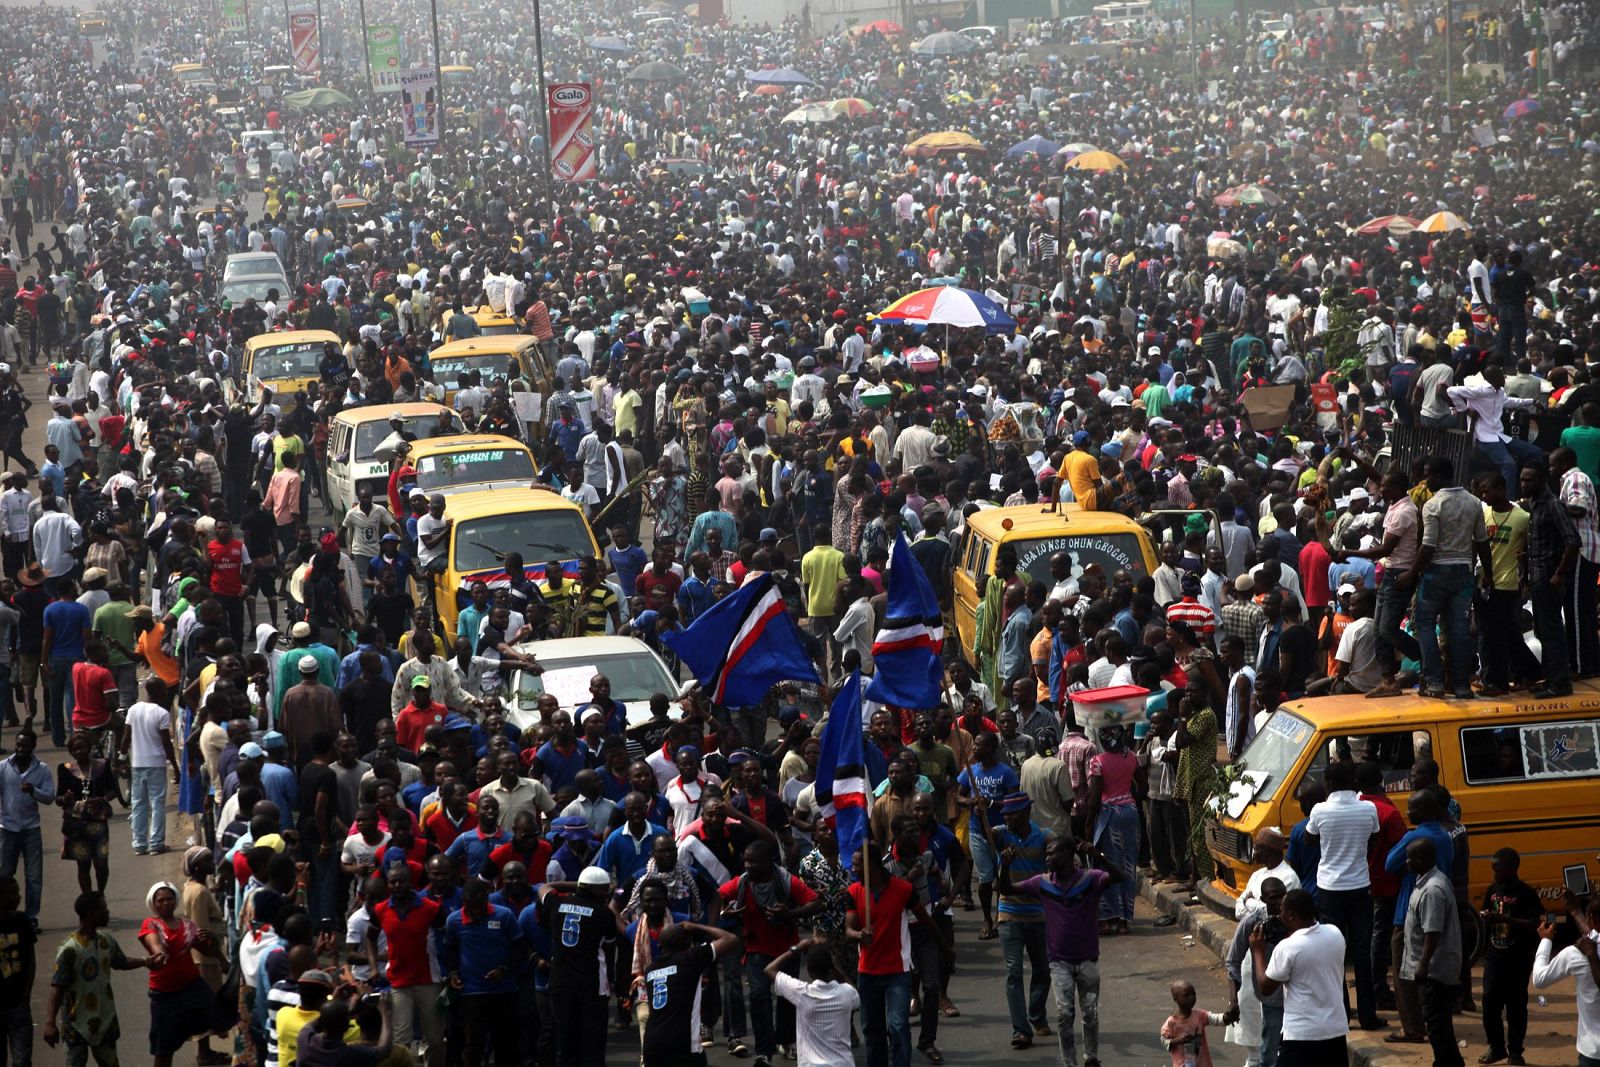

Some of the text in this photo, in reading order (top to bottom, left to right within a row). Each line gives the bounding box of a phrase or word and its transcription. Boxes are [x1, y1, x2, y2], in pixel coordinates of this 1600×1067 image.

[556, 90, 583, 100] Gala
[578, 132, 592, 144] Gala
[558, 160, 571, 173] Gala
[1016, 549, 1037, 572] BABA
[1068, 538, 1094, 549] OHUN
[1094, 540, 1130, 566] GBOGBO
[1513, 702, 1570, 712] THANK
[561, 913, 581, 947] 5
[652, 975, 668, 1010] 5
